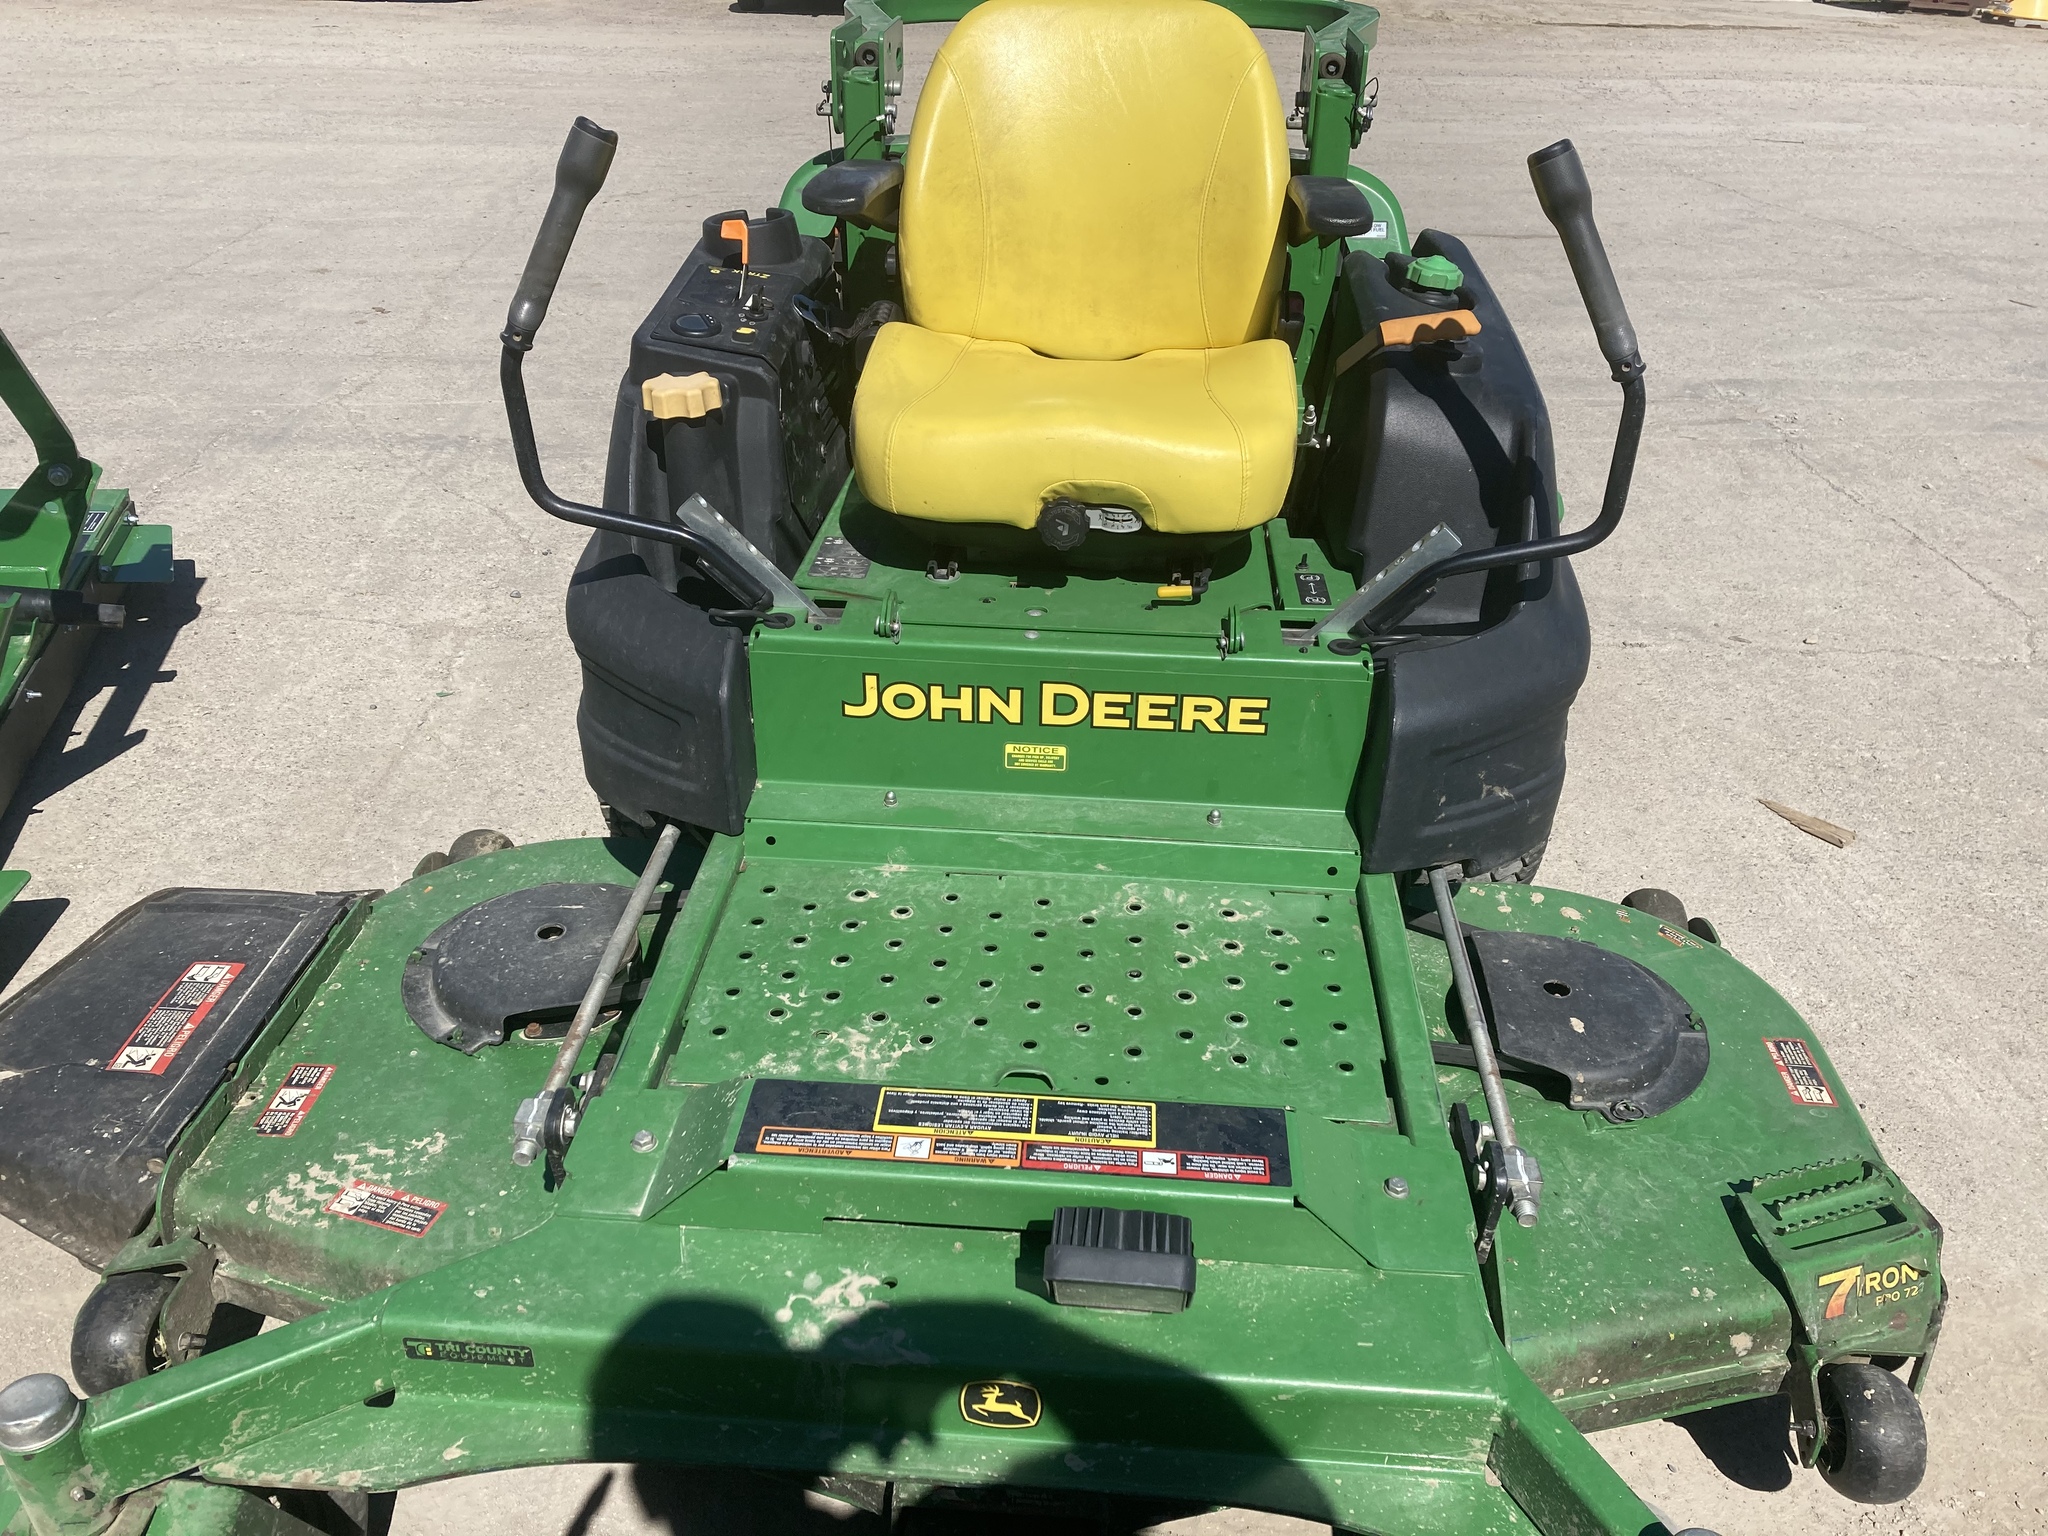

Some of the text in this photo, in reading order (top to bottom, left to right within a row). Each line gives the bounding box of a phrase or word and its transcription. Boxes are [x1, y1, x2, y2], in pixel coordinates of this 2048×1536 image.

[842, 672, 1270, 735] JOHN DEERE
[1012, 745, 1058, 753] NOTICE
[163, 1029, 190, 1057] PELIGRO
[367, 1183, 395, 1197] DANGER
[410, 1195, 440, 1209] PELIGRO
[434, 1342, 529, 1357] TRI COUNTY
[439, 1351, 524, 1363] EQUIPMENT
